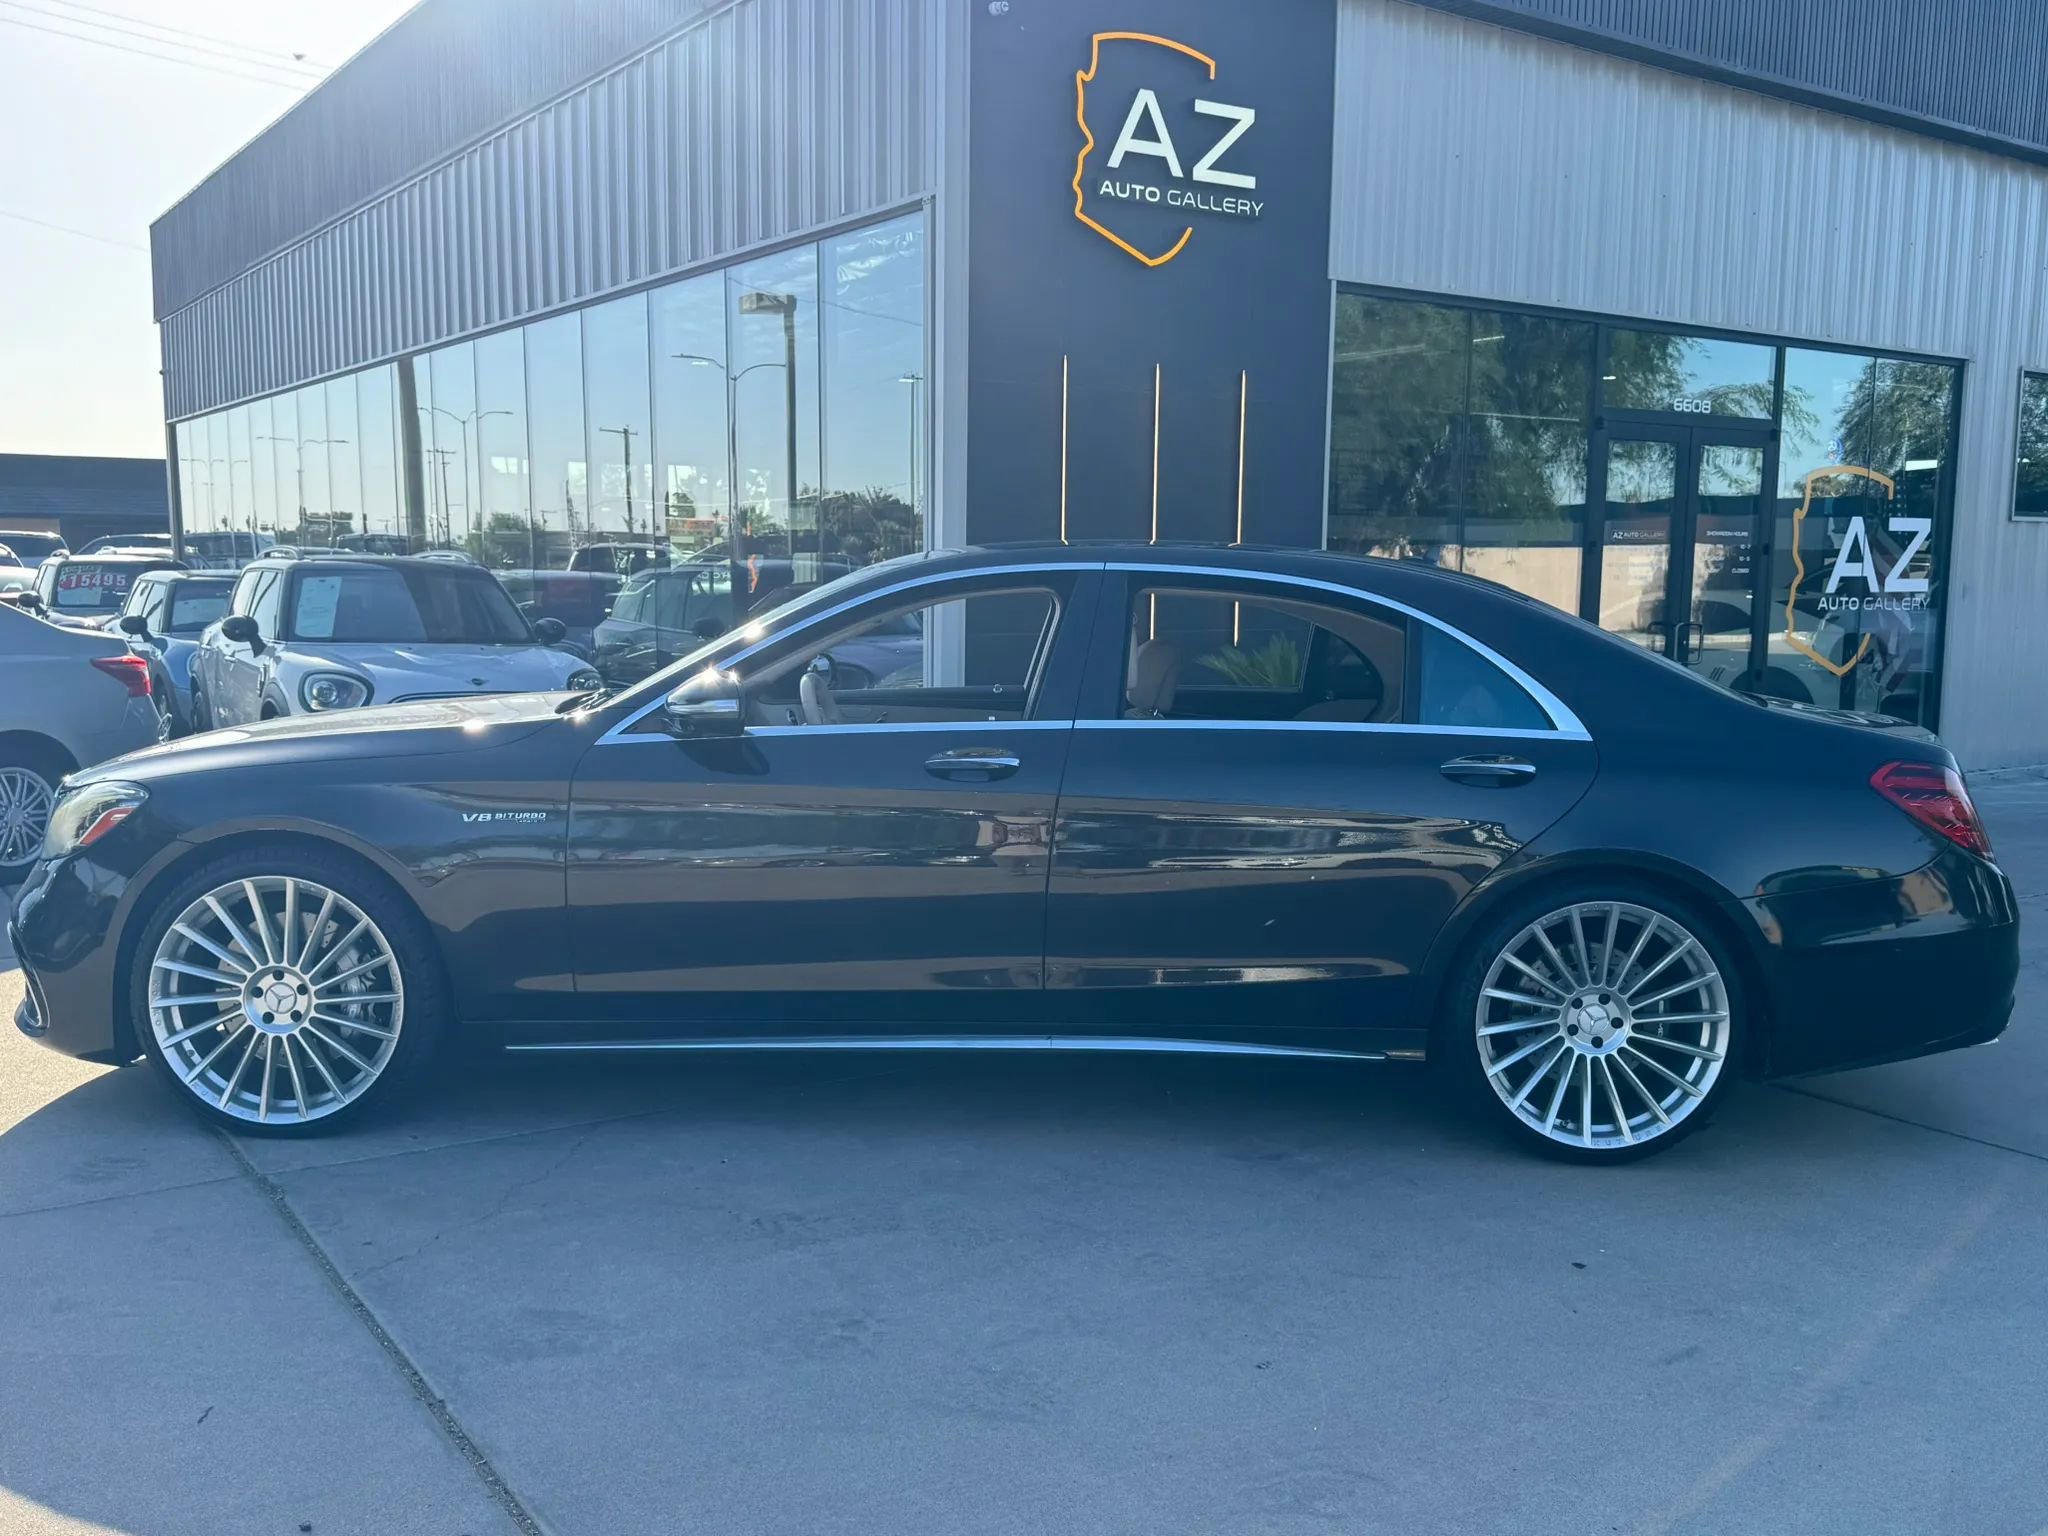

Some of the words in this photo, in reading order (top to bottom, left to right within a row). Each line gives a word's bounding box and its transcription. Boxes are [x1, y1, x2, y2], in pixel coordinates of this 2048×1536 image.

[1107, 88, 1256, 189] AZ
[1100, 180, 1160, 202] AUTO
[1167, 190, 1264, 216] GALLERY
[1673, 398, 1711, 414] 6608
[1825, 516, 1931, 594] AZ
[1817, 597, 1860, 611] AUTO
[1863, 597, 1931, 611] GALLERY
[462, 813, 492, 822] V8
[495, 812, 547, 820] BITURBO
